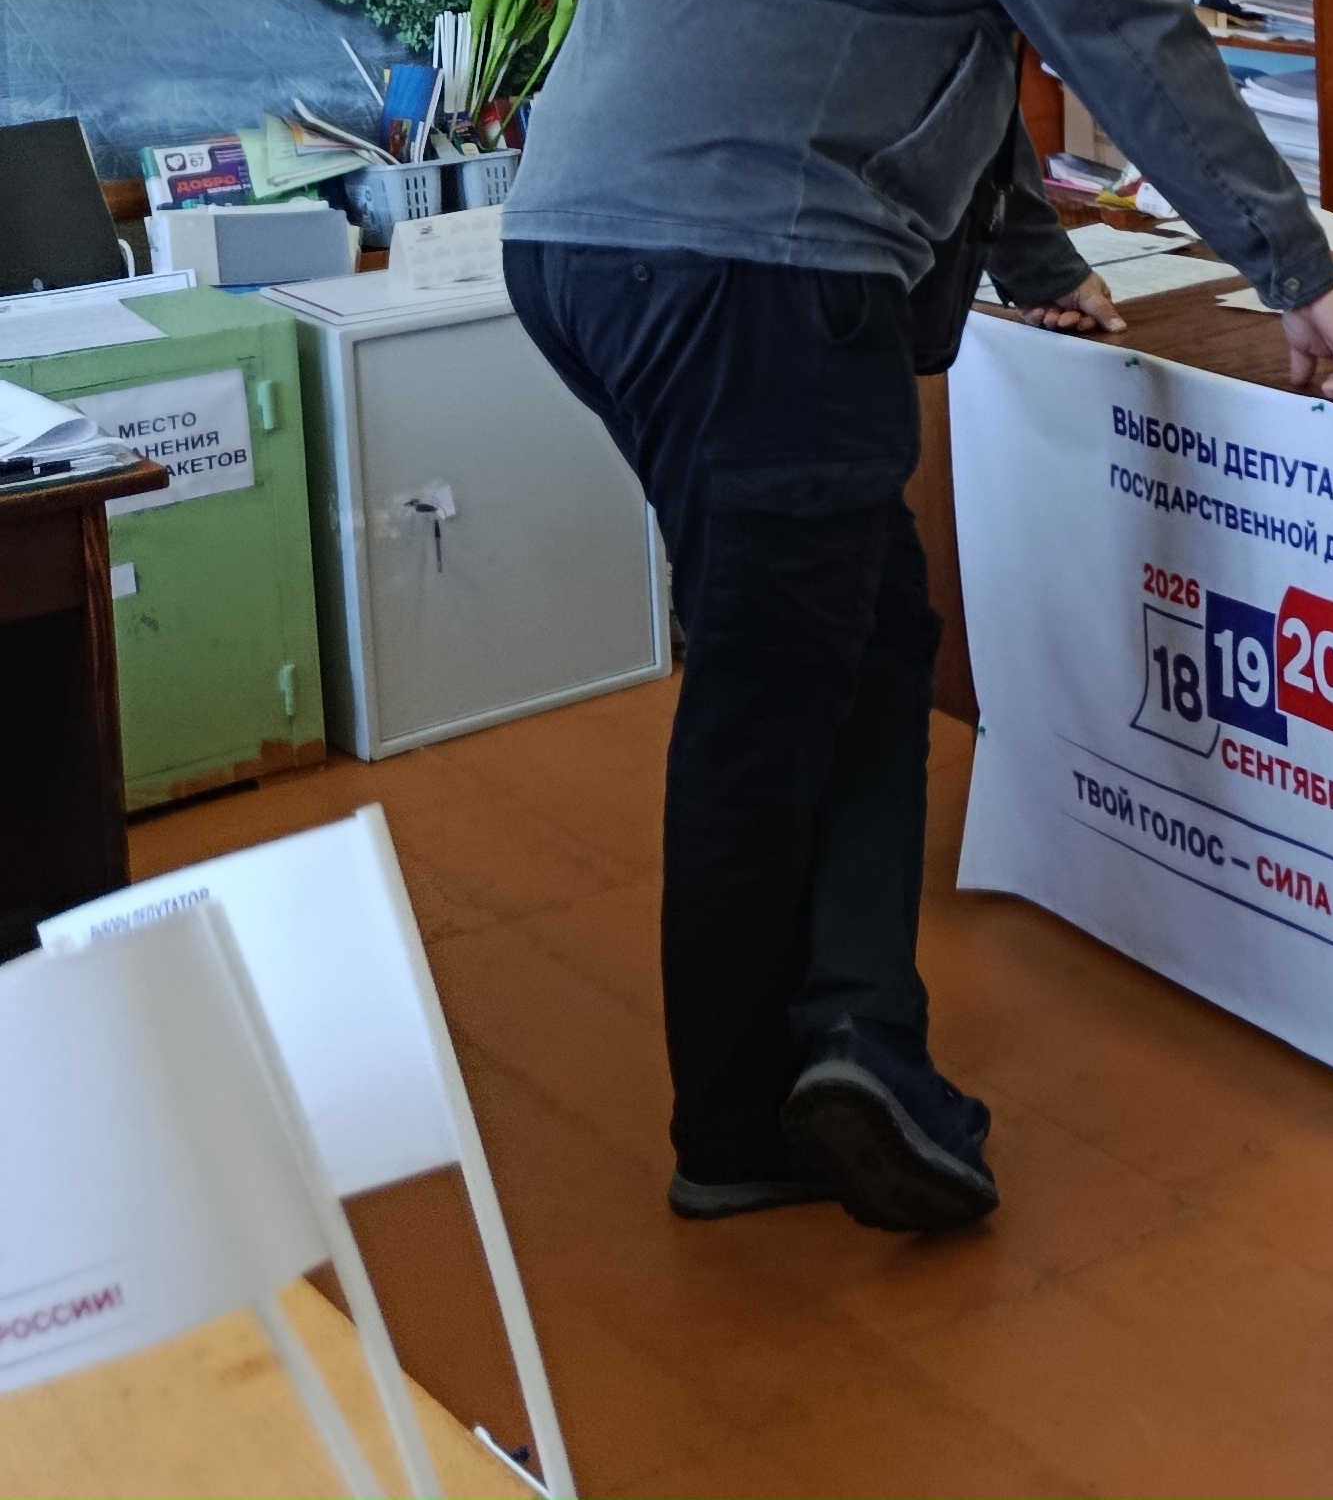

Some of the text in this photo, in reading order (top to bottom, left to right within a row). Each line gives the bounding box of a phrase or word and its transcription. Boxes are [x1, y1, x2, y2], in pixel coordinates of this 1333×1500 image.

[176, 174, 239, 195] ДОБРО
[189, 155, 205, 168] 67
[118, 411, 197, 439] МЕСТО
[1111, 404, 1218, 467] ВЫБОРЫ
[165, 448, 248, 478] АКЕТОВ
[1110, 463, 1318, 556] ГОСУДАРСТВЕННОЙ
[1143, 562, 1200, 610] 2026
[1153, 645, 1203, 722] 18
[1213, 629, 1270, 708] 19
[1073, 770, 1134, 826] ТВОЙ
[1140, 806, 1225, 866] ГОЛОС
[1256, 855, 1332, 915] СИЛА
